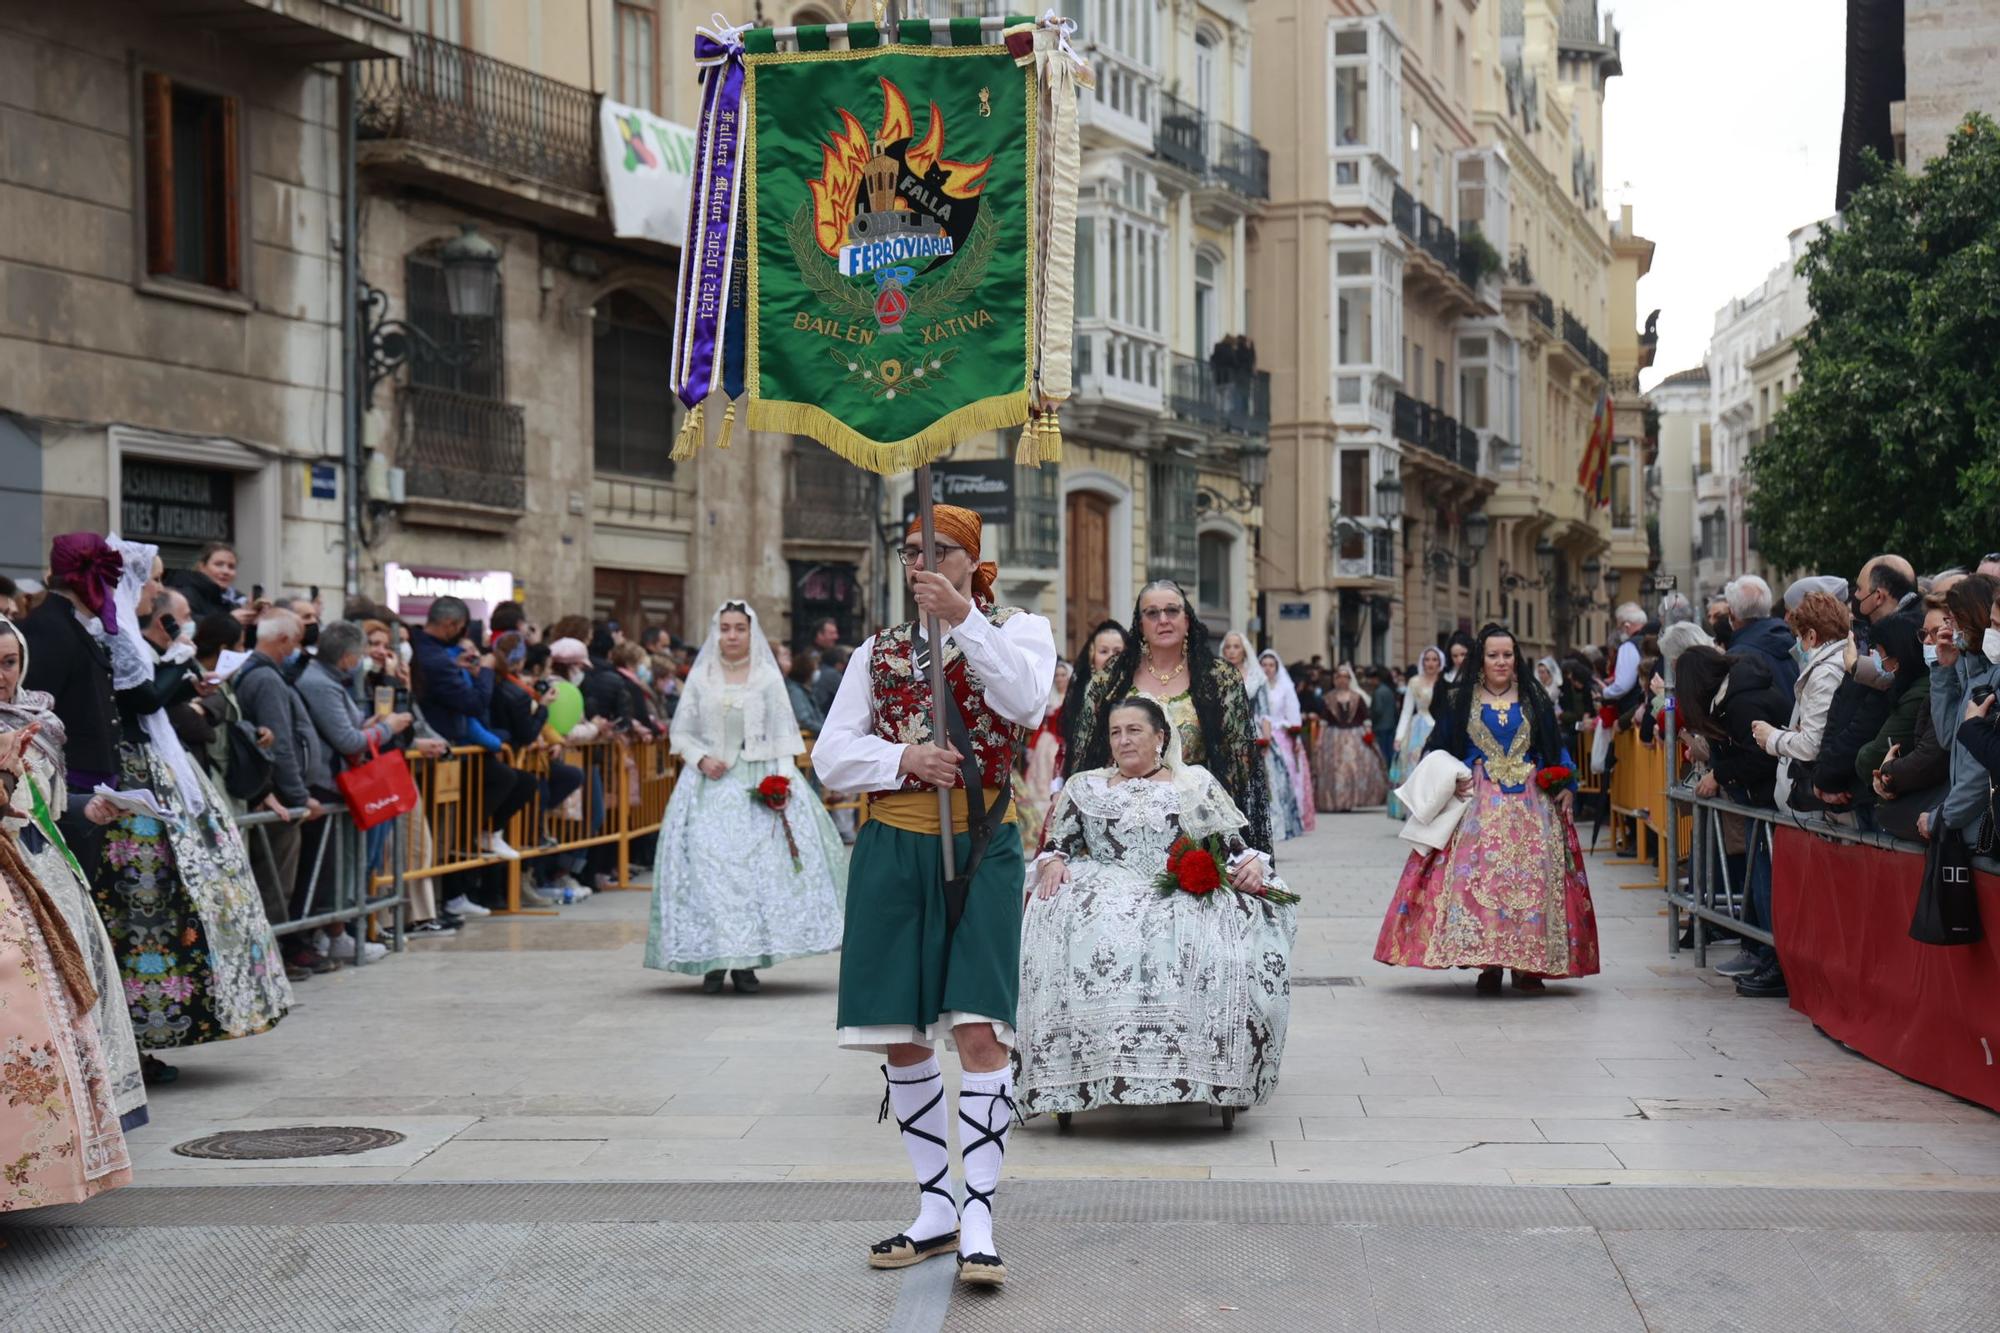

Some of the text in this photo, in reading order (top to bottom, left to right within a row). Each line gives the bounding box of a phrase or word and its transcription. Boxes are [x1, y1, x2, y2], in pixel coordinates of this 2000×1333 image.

[700, 110, 735, 320] Fallera Major 2020 i 2021
[899, 175, 953, 222] FALLA
[849, 236, 954, 277] FERROVIARIA
[920, 308, 995, 345] XÀTIVA
